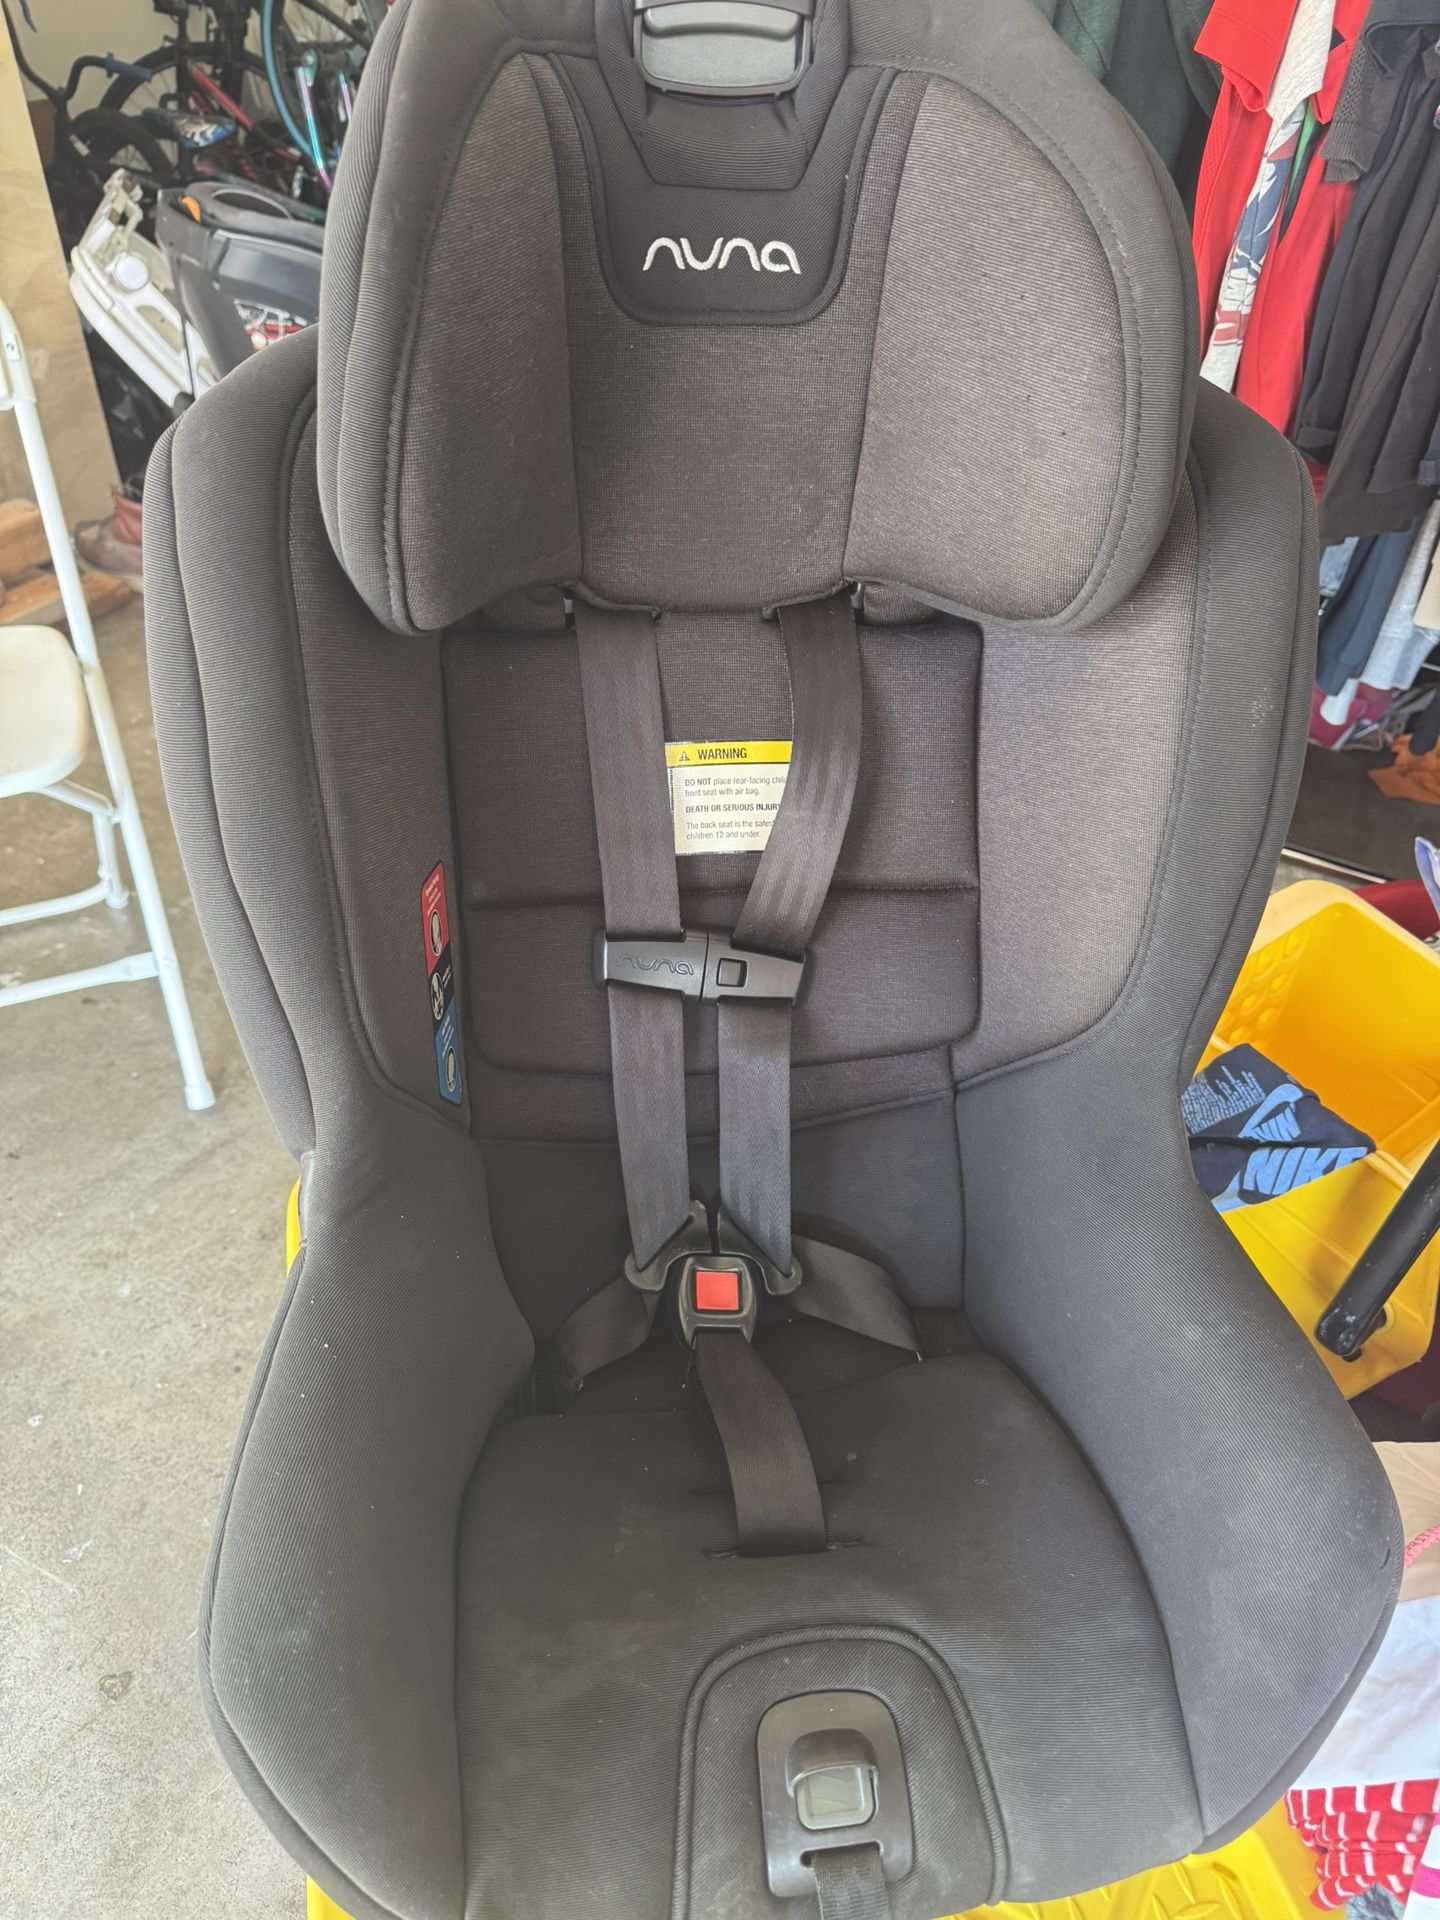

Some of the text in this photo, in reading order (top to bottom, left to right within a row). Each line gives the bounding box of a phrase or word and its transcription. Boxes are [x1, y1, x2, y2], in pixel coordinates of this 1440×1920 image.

[642, 236, 802, 275] nuna
[697, 748, 748, 760] WARNING
[684, 778, 695, 787] DO
[697, 777, 712, 786] NOT
[713, 777, 732, 788] place
[733, 776, 771, 787] rear-facing
[685, 789, 701, 797] front
[702, 788, 717, 796] seat
[719, 788, 733, 796] with
[745, 787, 761, 796] bag.
[685, 805, 709, 813] DEATH
[711, 804, 721, 812] OR
[723, 803, 754, 812] SERIOUS
[686, 821, 699, 830] The
[700, 821, 717, 829] back
[718, 820, 733, 828] seat
[734, 820, 741, 828] is
[742, 820, 753, 828] the
[686, 831, 714, 840] children
[715, 831, 724, 839] 12
[740, 830, 761, 838] under.
[615, 953, 695, 976] nuna
